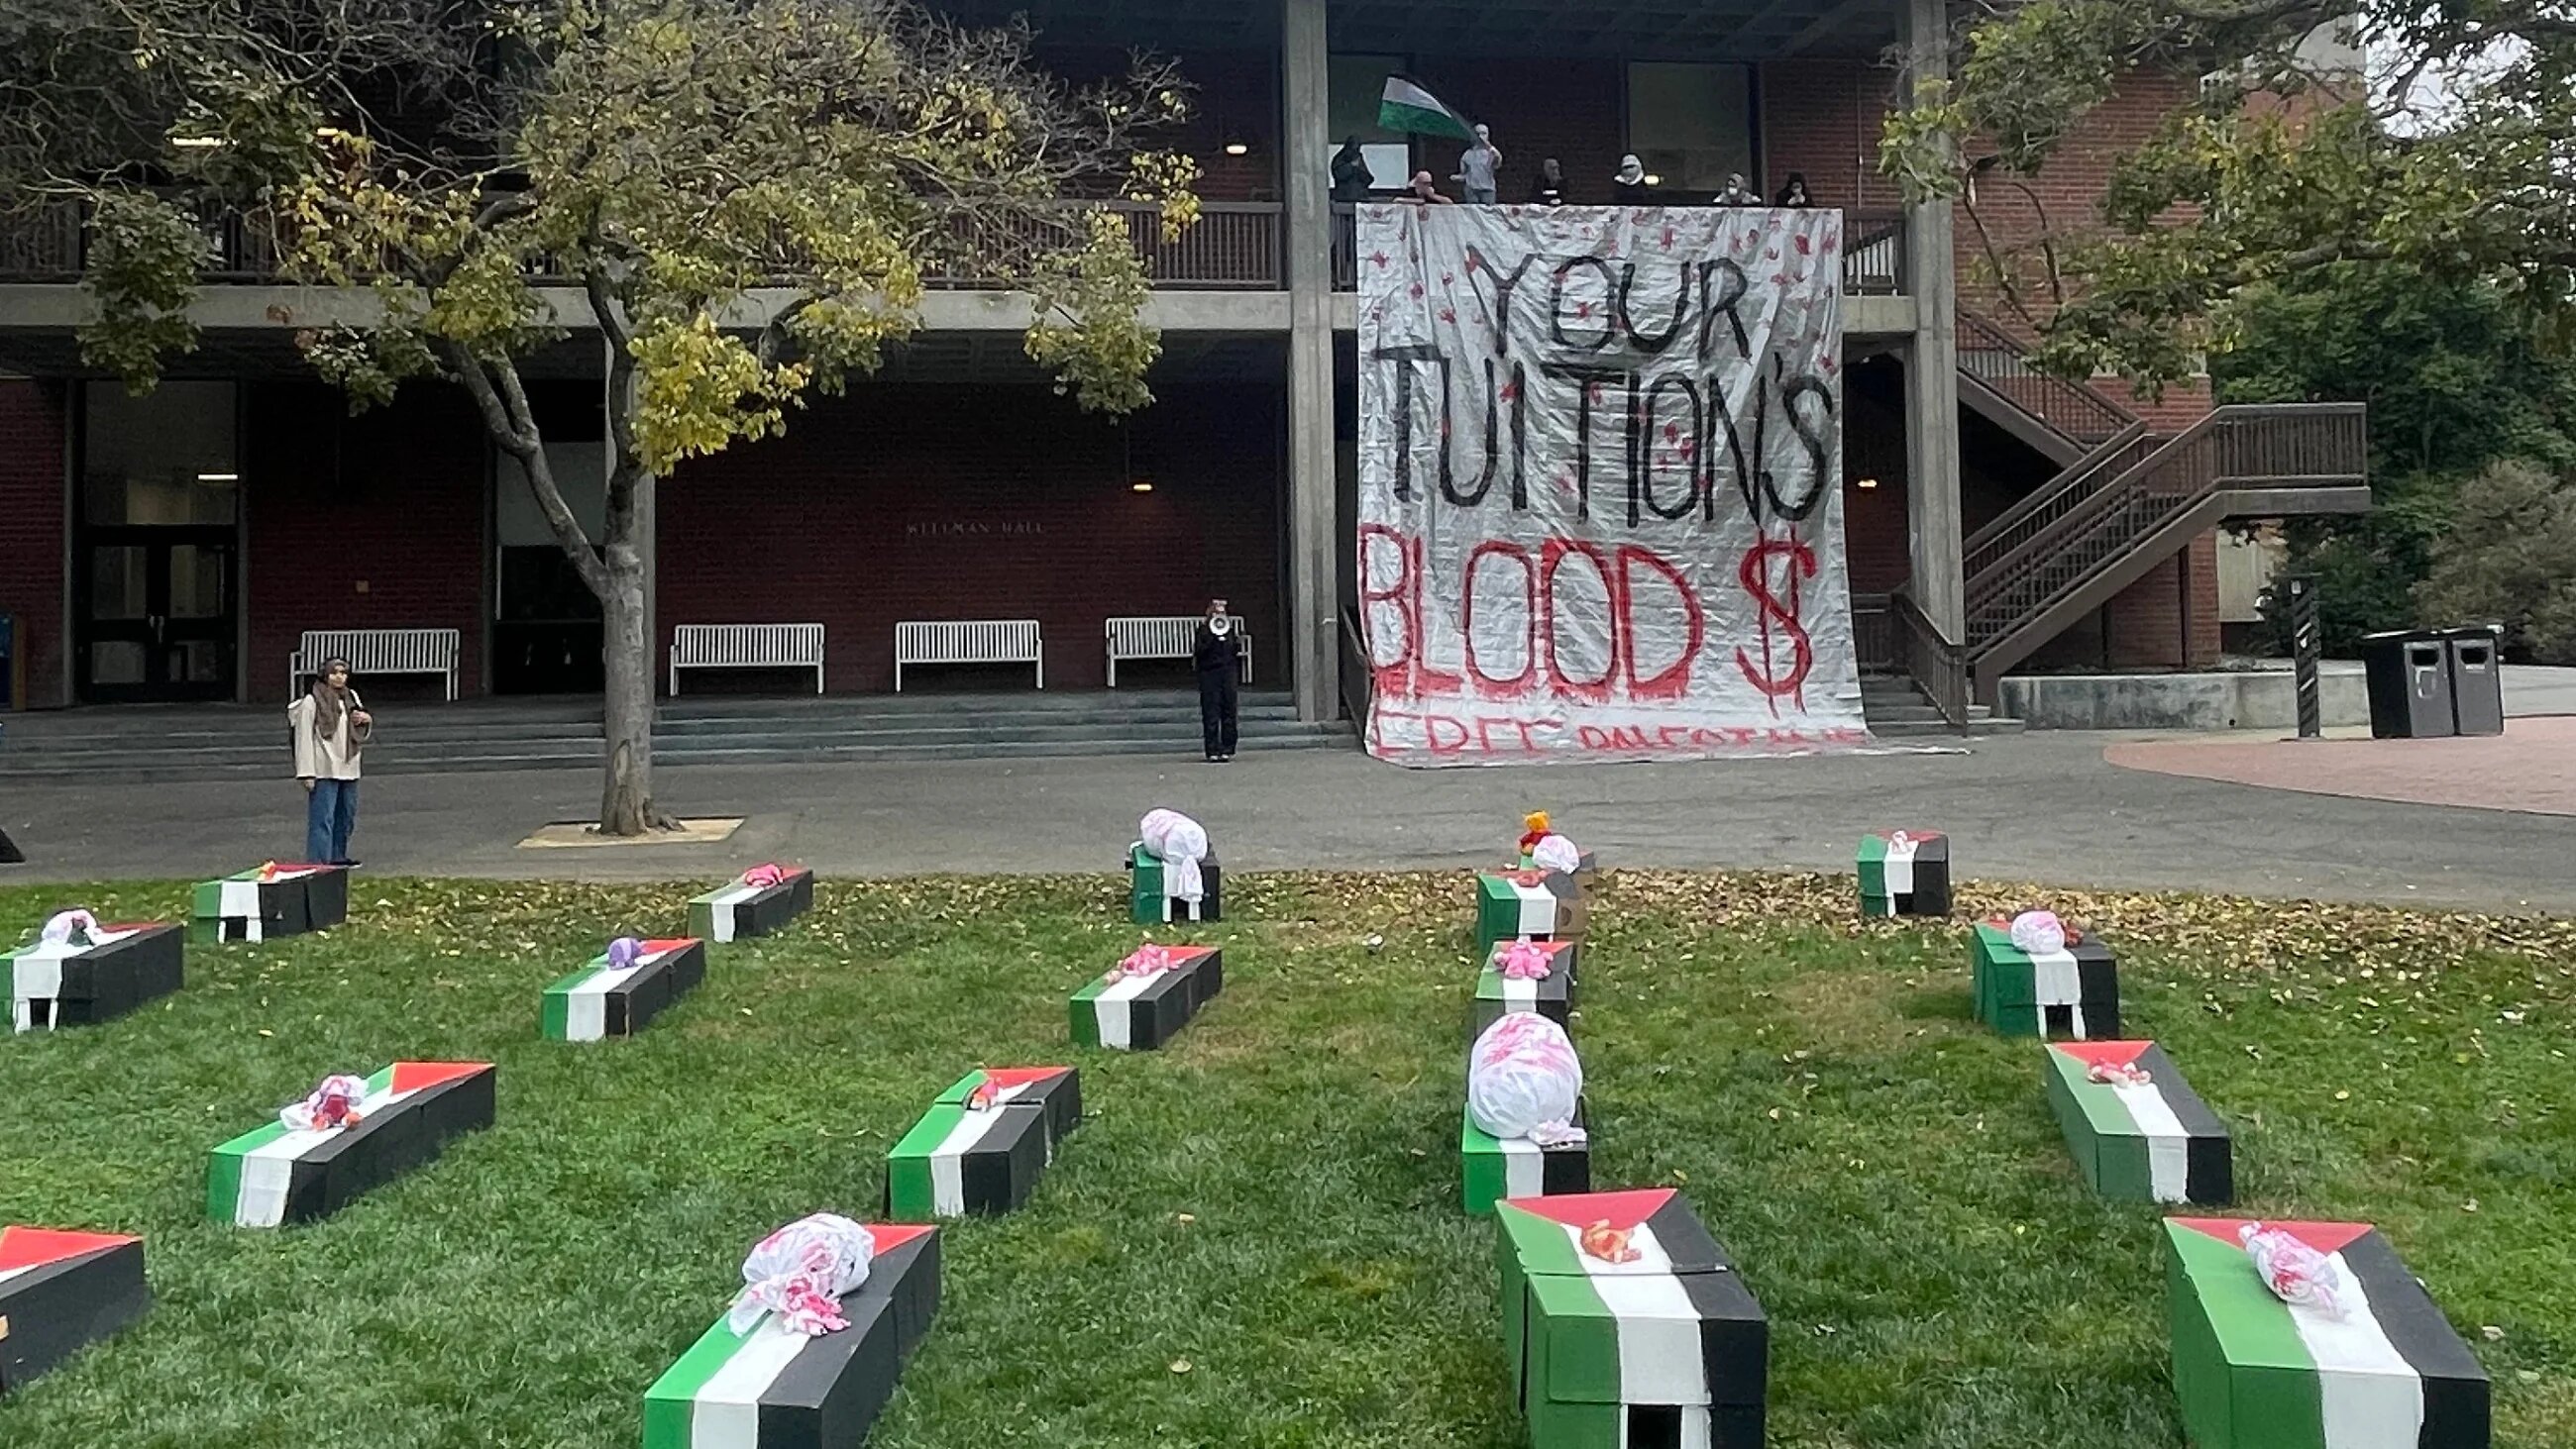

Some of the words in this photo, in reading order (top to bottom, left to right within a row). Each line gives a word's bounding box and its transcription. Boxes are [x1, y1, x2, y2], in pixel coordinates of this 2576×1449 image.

[1465, 244, 1752, 360] YOUR
[1371, 344, 1835, 528] TUITION'S
[1357, 524, 1704, 701] BLOOD
[1736, 525, 1818, 720] $
